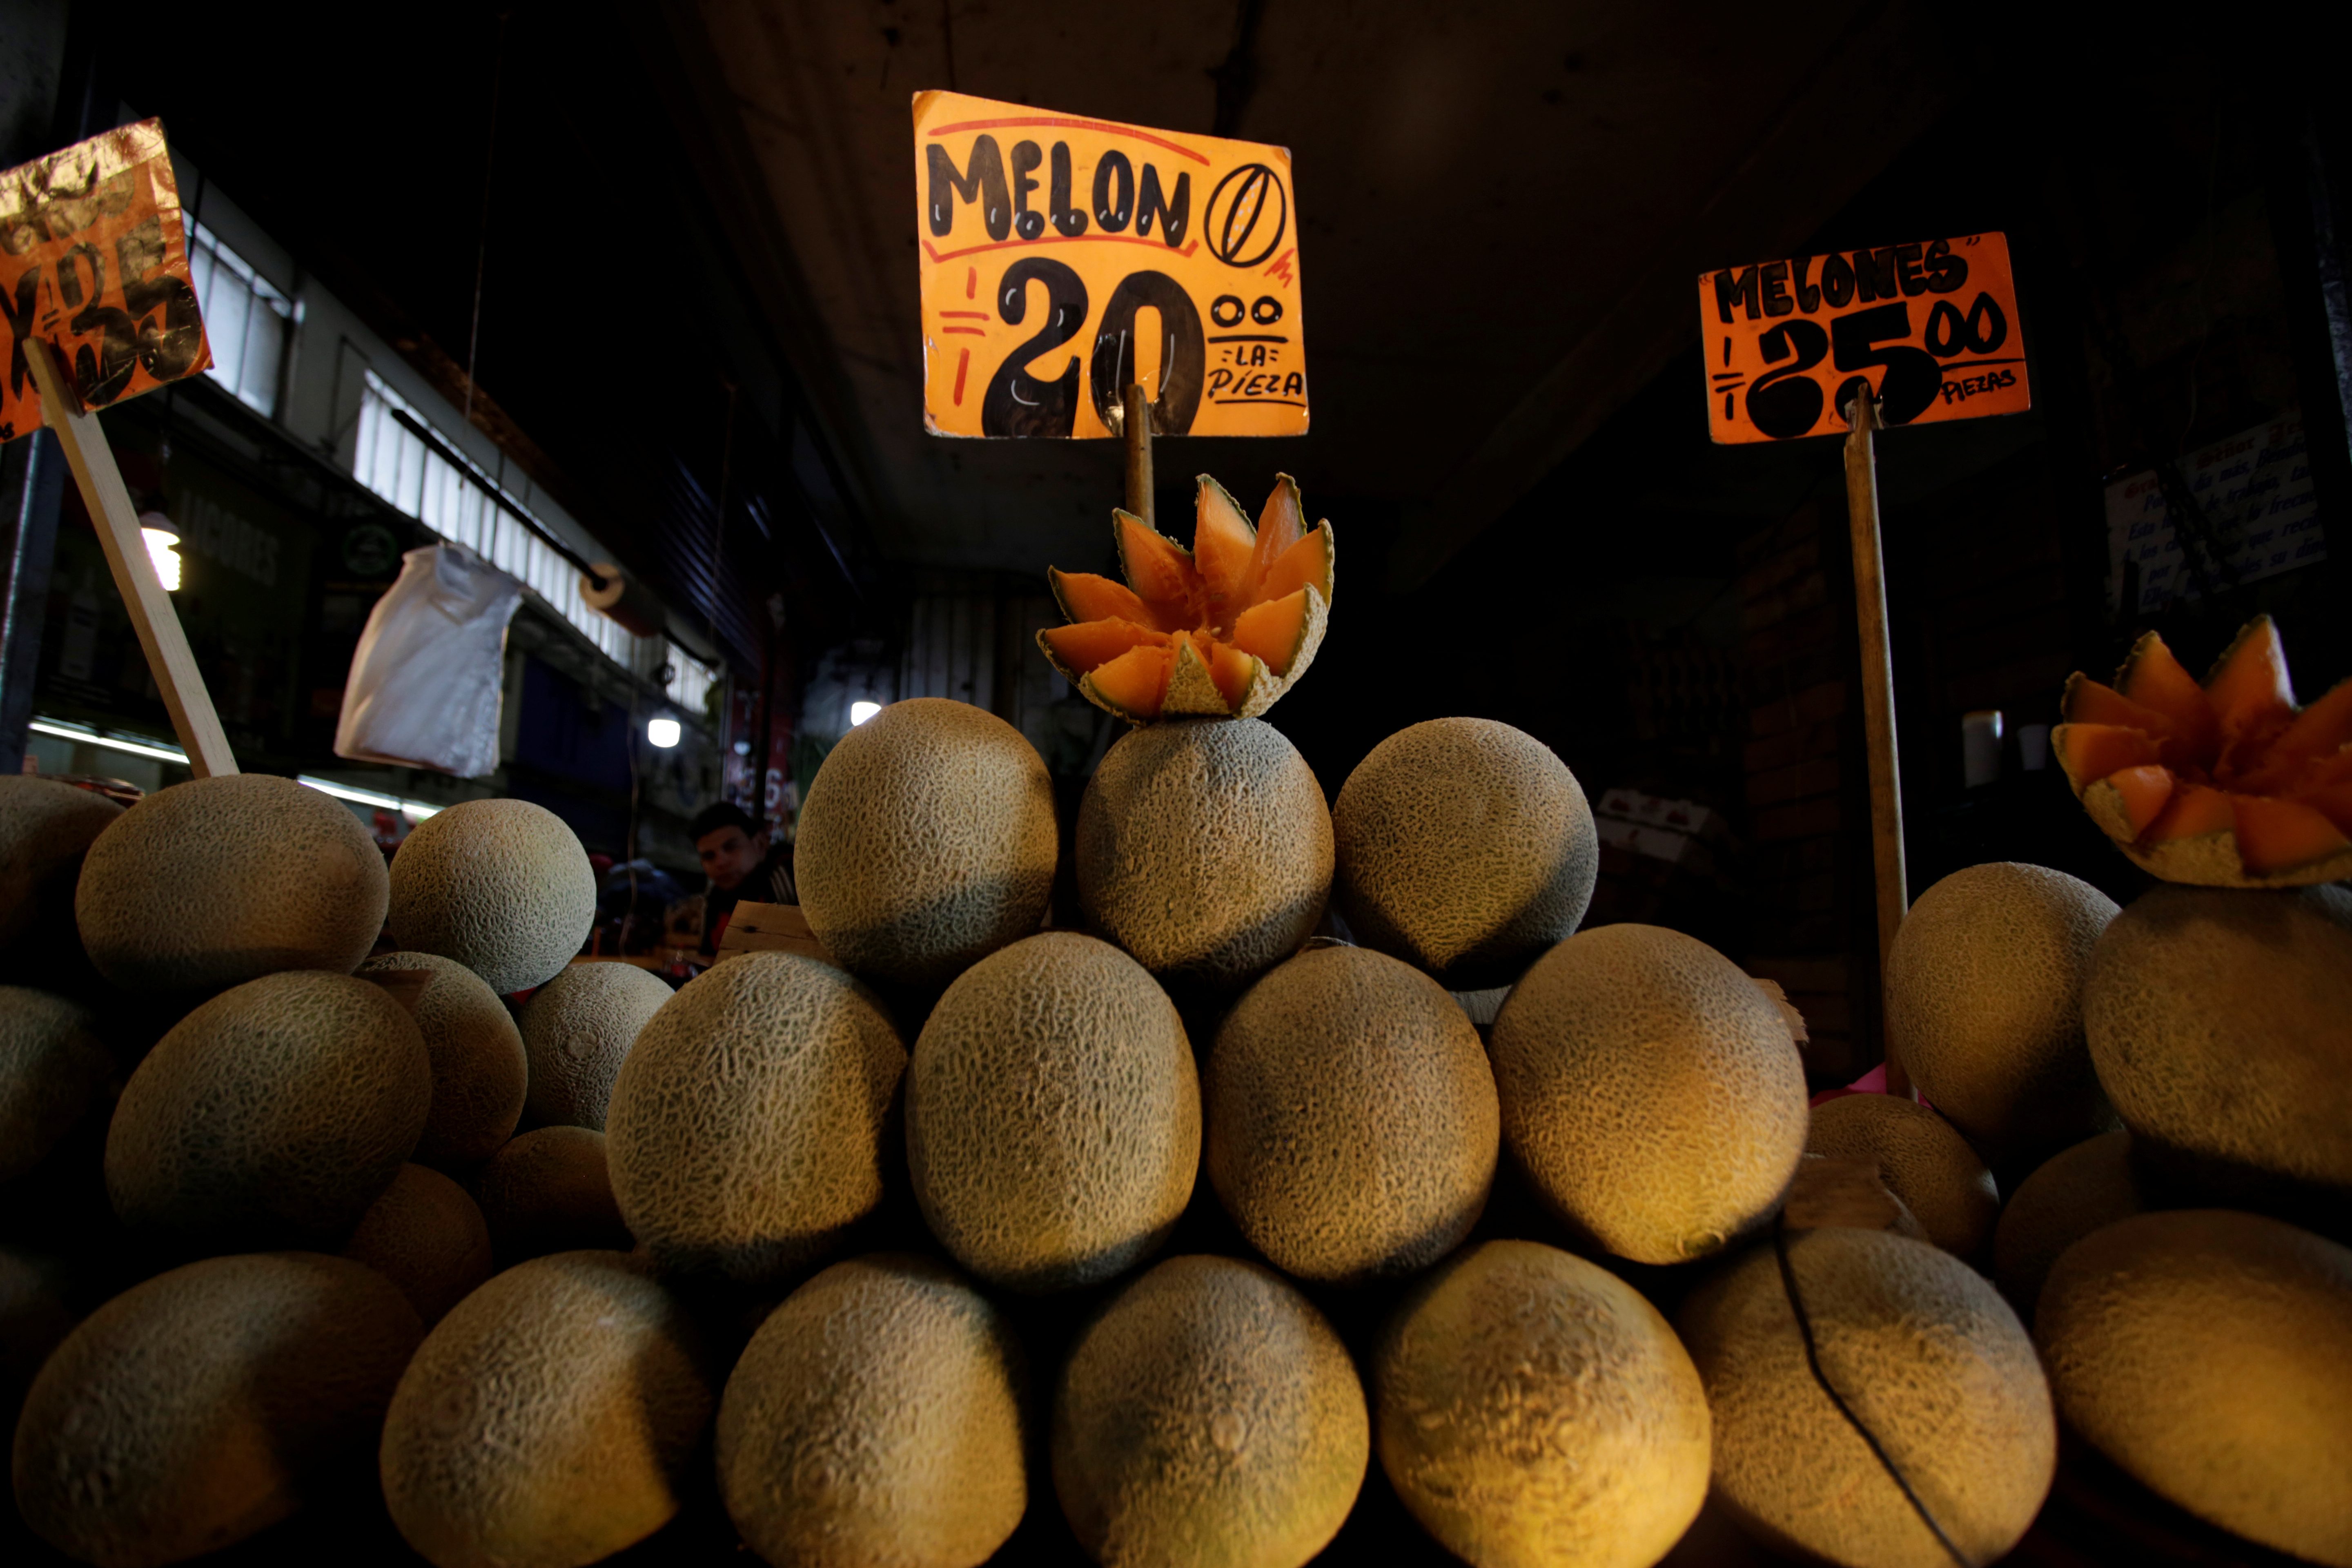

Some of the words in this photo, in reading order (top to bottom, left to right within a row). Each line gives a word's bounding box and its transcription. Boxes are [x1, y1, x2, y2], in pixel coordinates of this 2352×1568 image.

[926, 134, 1190, 247] MELON
[982, 257, 1205, 437] 20
[1210, 295, 1283, 327] 00
[1236, 345, 1266, 367] LA
[1746, 301, 1942, 439] 25
[1924, 292, 2008, 357] 00
[1941, 369, 2016, 405] PIEZAS
[2196, 437, 2256, 470] Señor
[2269, 551, 2287, 567] su
